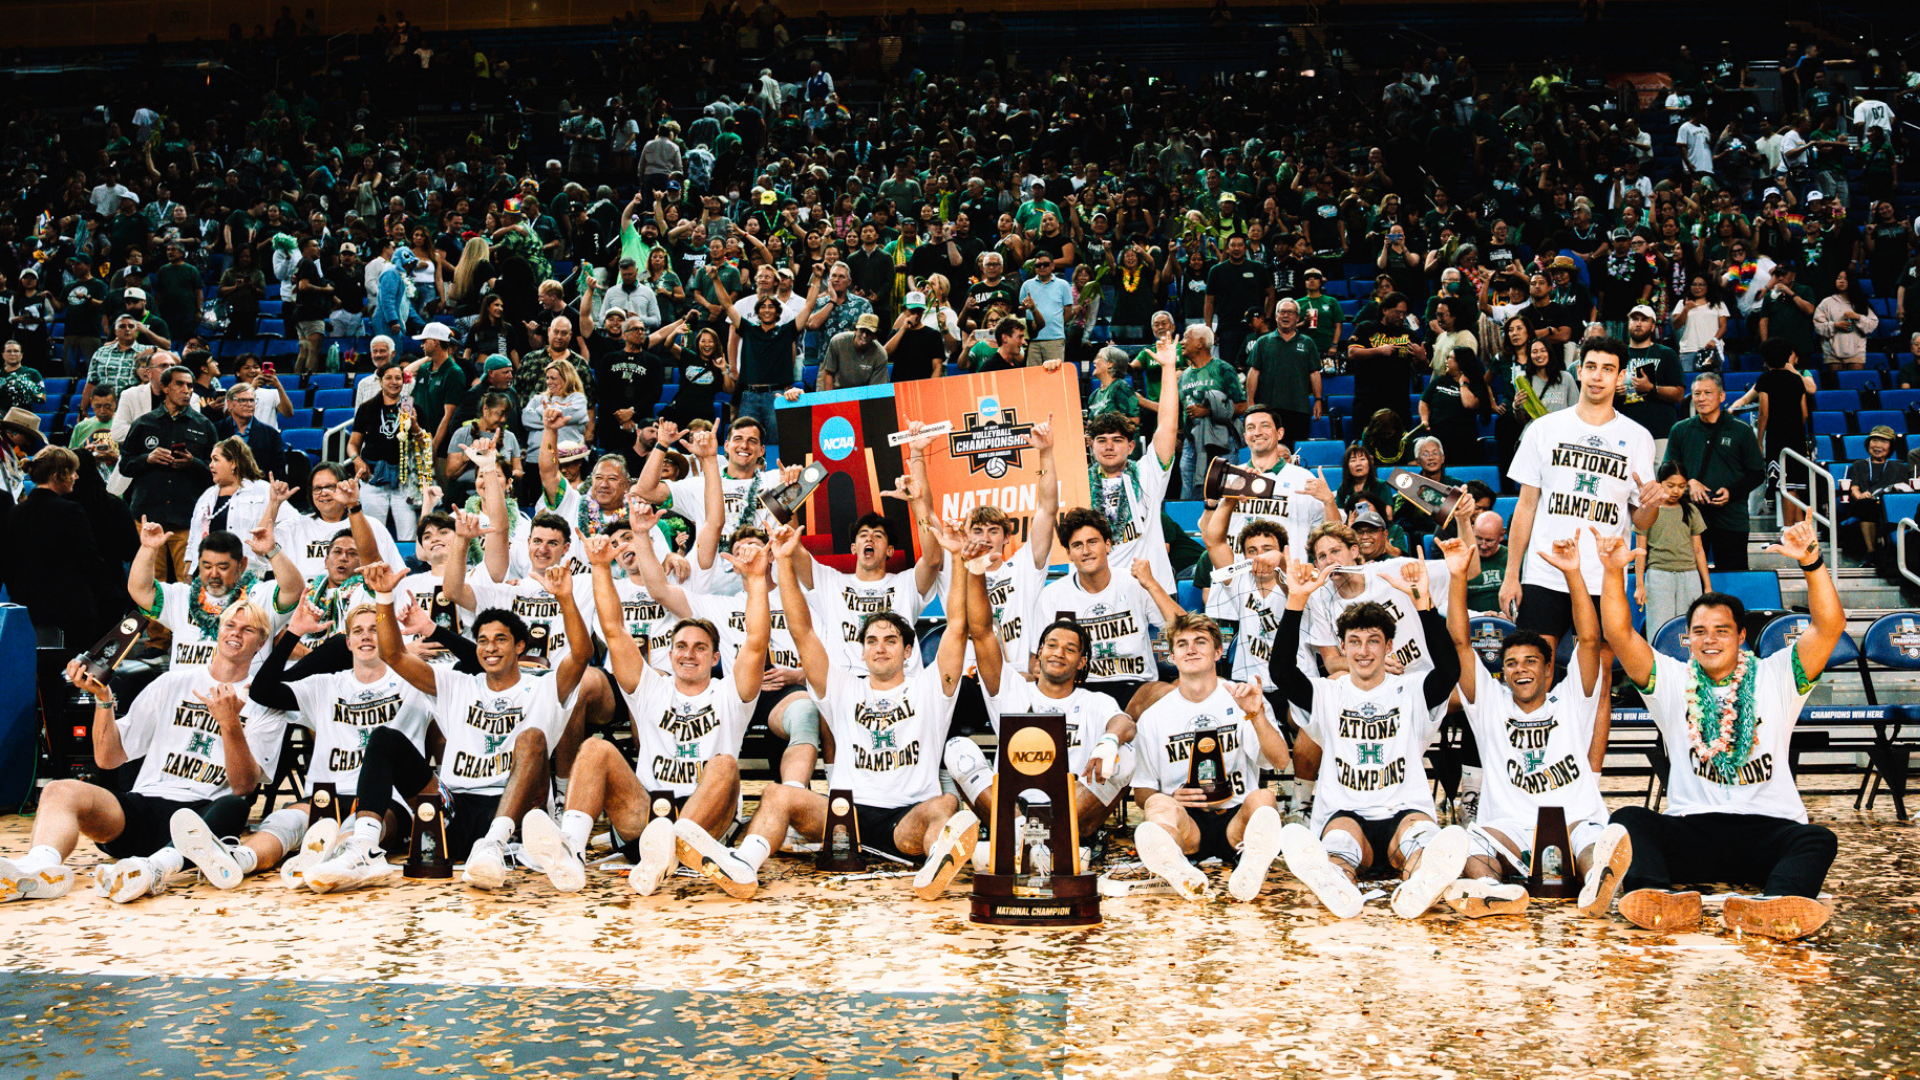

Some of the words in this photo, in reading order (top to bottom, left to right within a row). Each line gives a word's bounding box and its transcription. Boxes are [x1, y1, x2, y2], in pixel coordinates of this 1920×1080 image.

[975, 291, 993, 304] HAW
[972, 428, 1012, 440] VOLLEYBALL
[824, 436, 854, 451] NCAA
[1552, 449, 1628, 481] NATIONAL
[942, 481, 1066, 520] NATIONL
[1233, 498, 1289, 518] ATIONAL
[1084, 617, 1139, 642] TIONAL
[1623, 712, 1637, 721] WIN
[1810, 710, 1851, 719] CHAMPIONS
[1851, 710, 1866, 719] WIN
[1867, 710, 1884, 719] HERE
[1012, 750, 1054, 764] NCAA
[1357, 743, 1384, 765] H
[996, 906, 1030, 917] NATIONAL
[1031, 906, 1071, 917] CHAMPION
